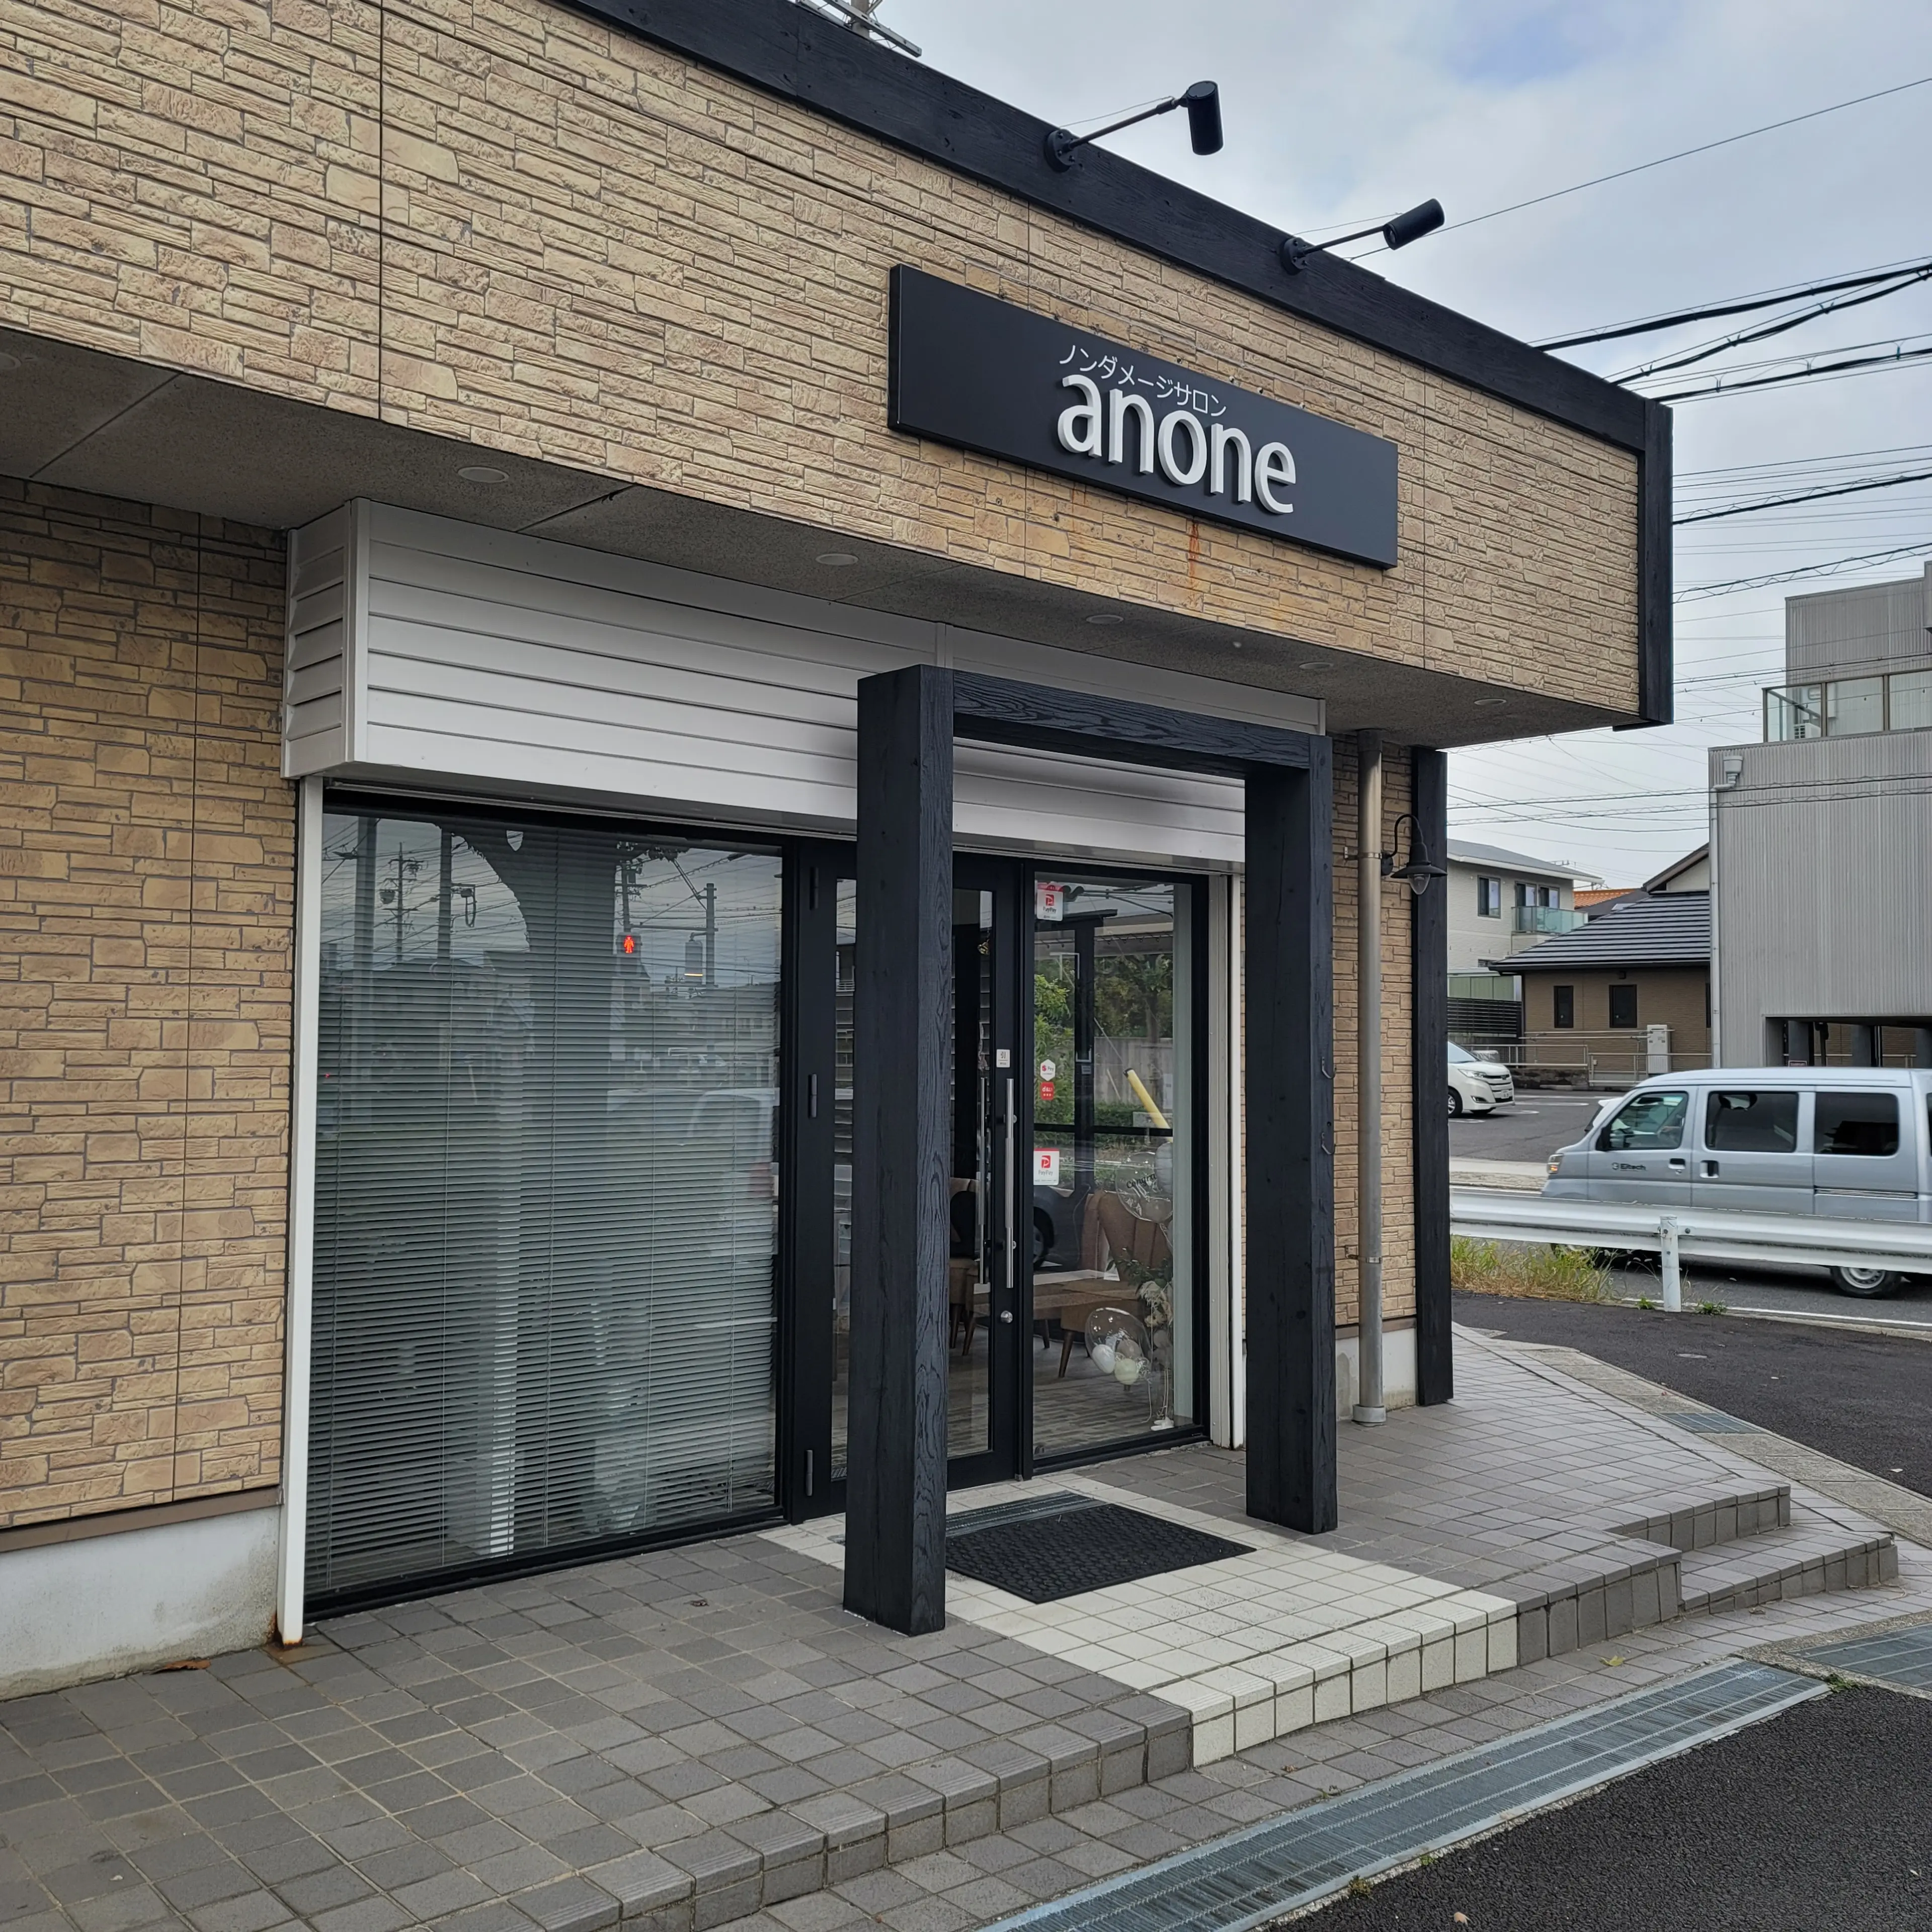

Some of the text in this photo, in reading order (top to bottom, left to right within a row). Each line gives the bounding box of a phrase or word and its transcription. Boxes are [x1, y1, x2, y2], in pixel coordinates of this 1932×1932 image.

[1060, 345, 1226, 416] ノンダメージサロン
[1058, 374, 1296, 514] anone
